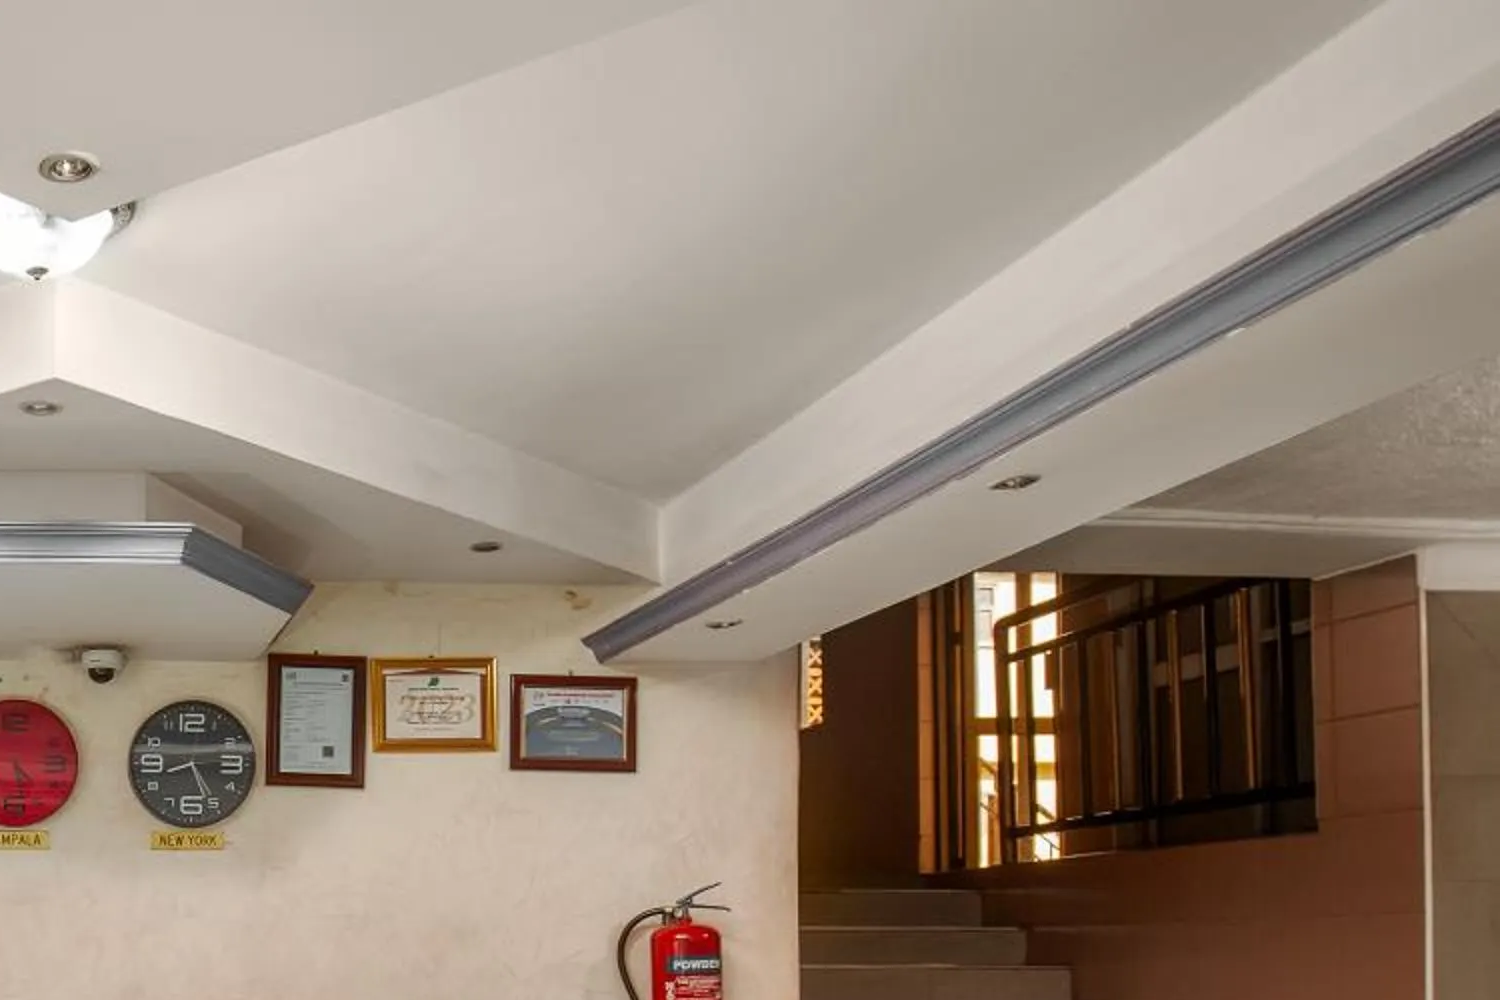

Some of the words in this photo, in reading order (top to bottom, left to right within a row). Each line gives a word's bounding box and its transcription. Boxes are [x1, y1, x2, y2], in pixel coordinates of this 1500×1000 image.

[179, 713, 205, 733] 12
[140, 753, 164, 773] 9
[220, 754, 243, 775] 3
[179, 795, 204, 815] 6
[159, 834, 185, 846] NEW
[187, 834, 217, 846] YORK
